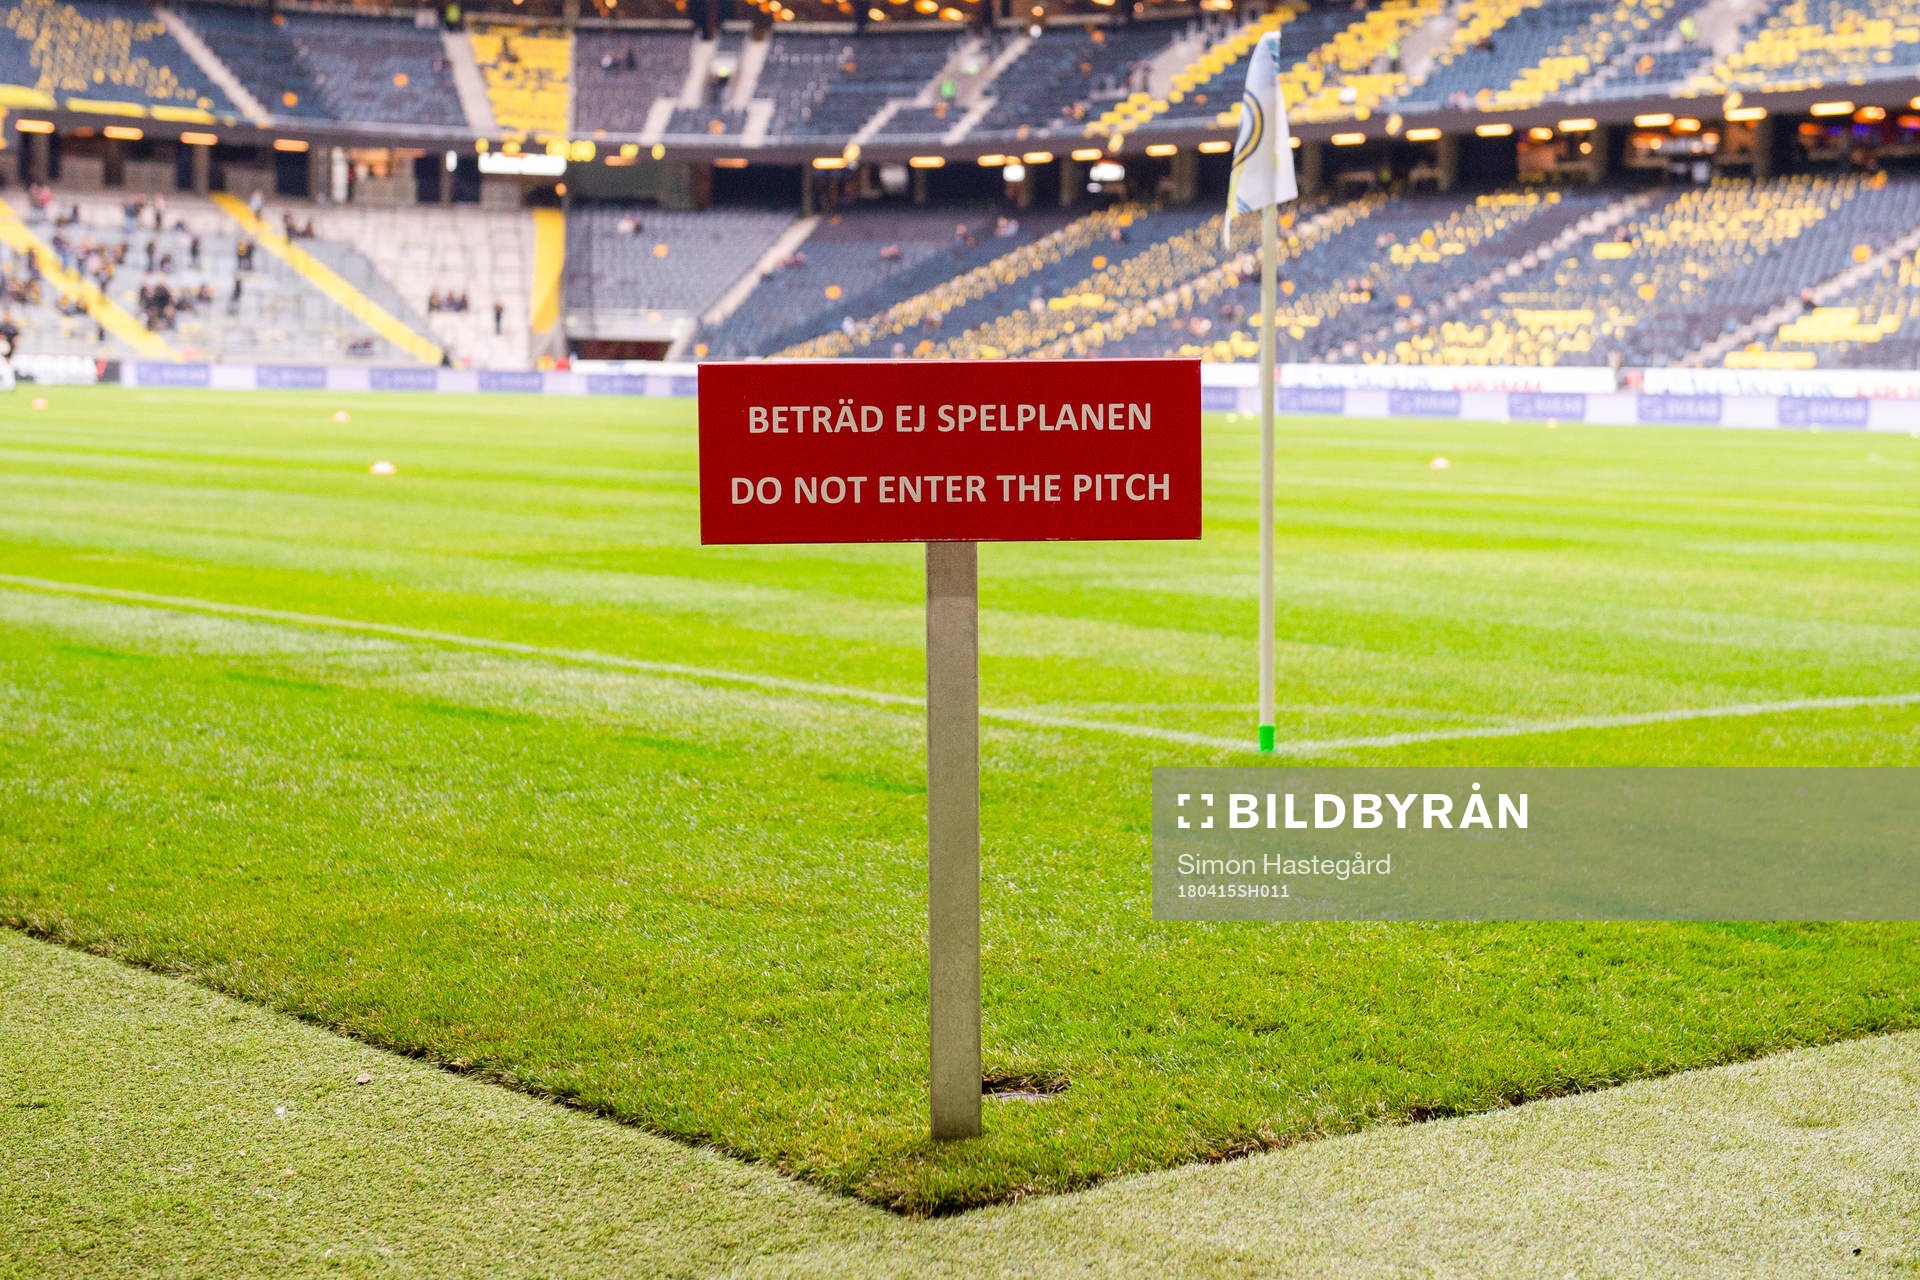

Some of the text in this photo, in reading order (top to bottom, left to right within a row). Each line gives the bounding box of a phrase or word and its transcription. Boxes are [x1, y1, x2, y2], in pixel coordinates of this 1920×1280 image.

[749, 398, 1151, 434] BETRÄD EJ SPELPLANEN
[731, 473, 1170, 505] DO NOT ENTER THE PITCH
